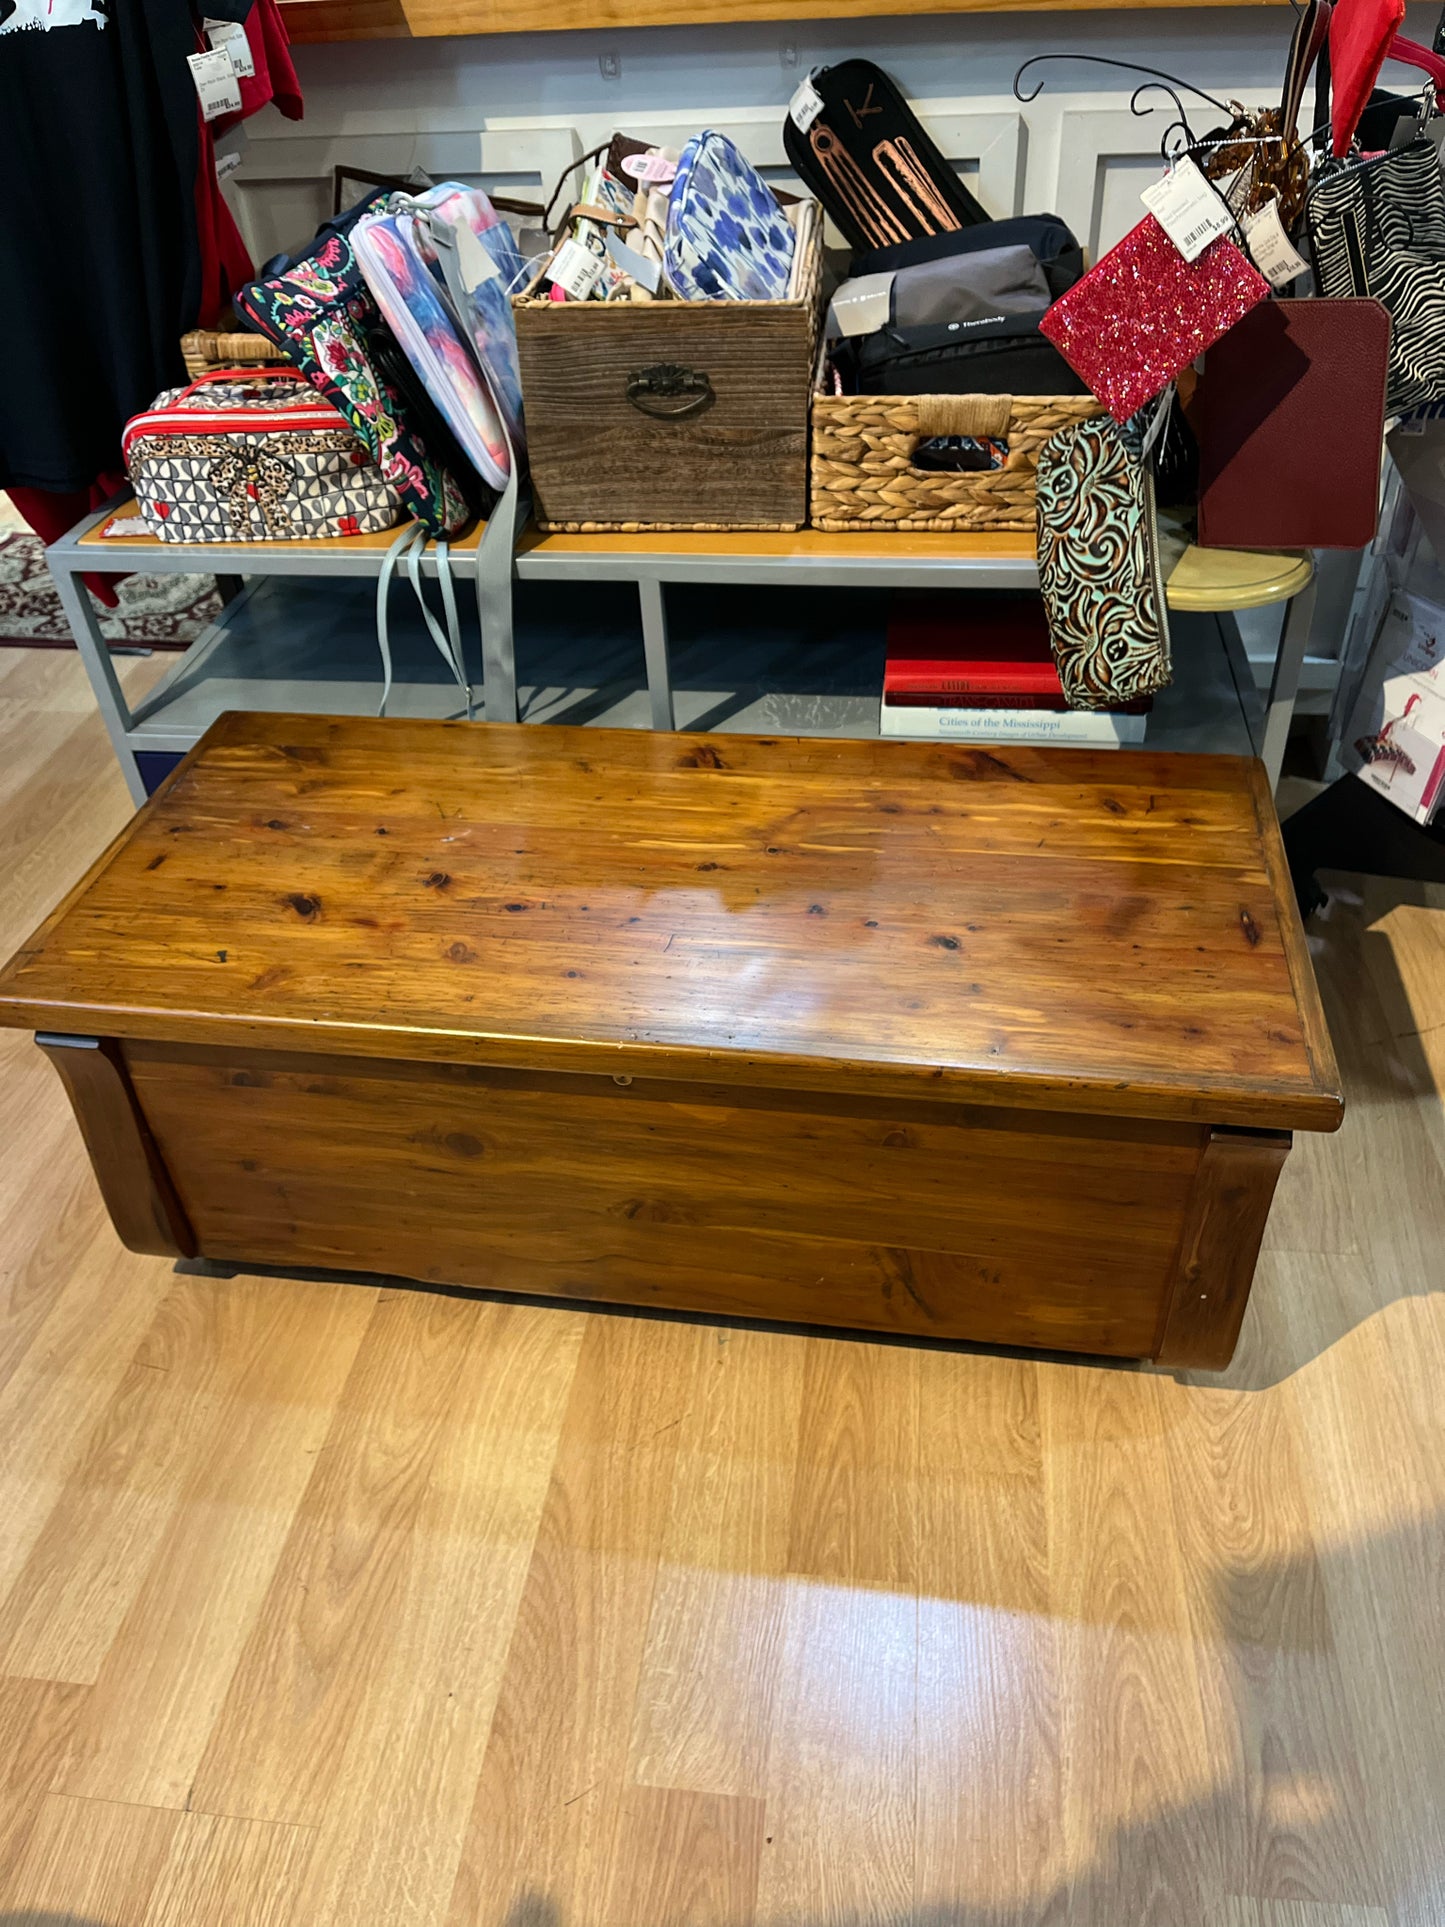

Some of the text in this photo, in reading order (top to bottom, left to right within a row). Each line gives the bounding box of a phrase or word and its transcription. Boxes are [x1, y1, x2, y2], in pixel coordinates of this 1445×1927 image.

[939, 717, 1061, 731] Cities of the Mississippi
